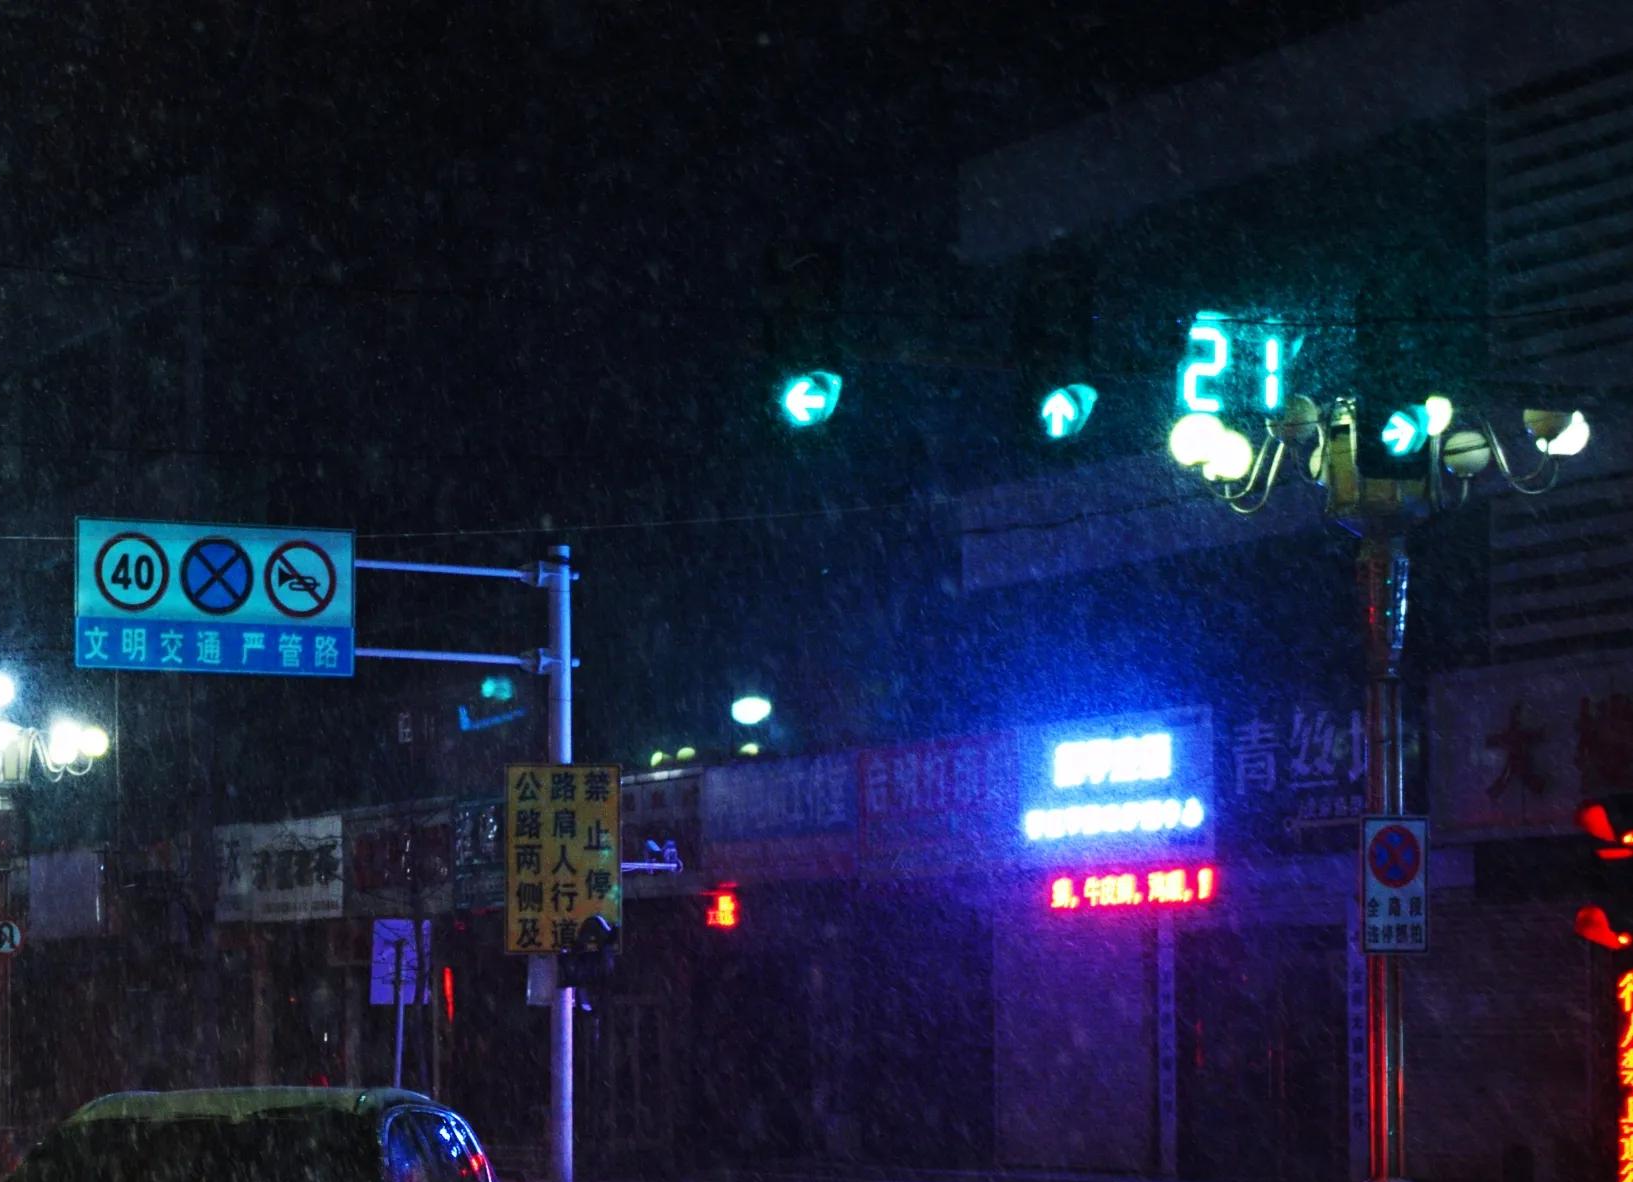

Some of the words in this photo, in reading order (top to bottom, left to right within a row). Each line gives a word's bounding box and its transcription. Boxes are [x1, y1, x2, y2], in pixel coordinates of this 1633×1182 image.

[1183, 324, 1280, 413] 21
[111, 553, 154, 591] 40
[515, 771, 544, 948] 公路两侧及
[550, 772, 579, 949] 路肩人行道
[583, 771, 612, 900] 禁止停
